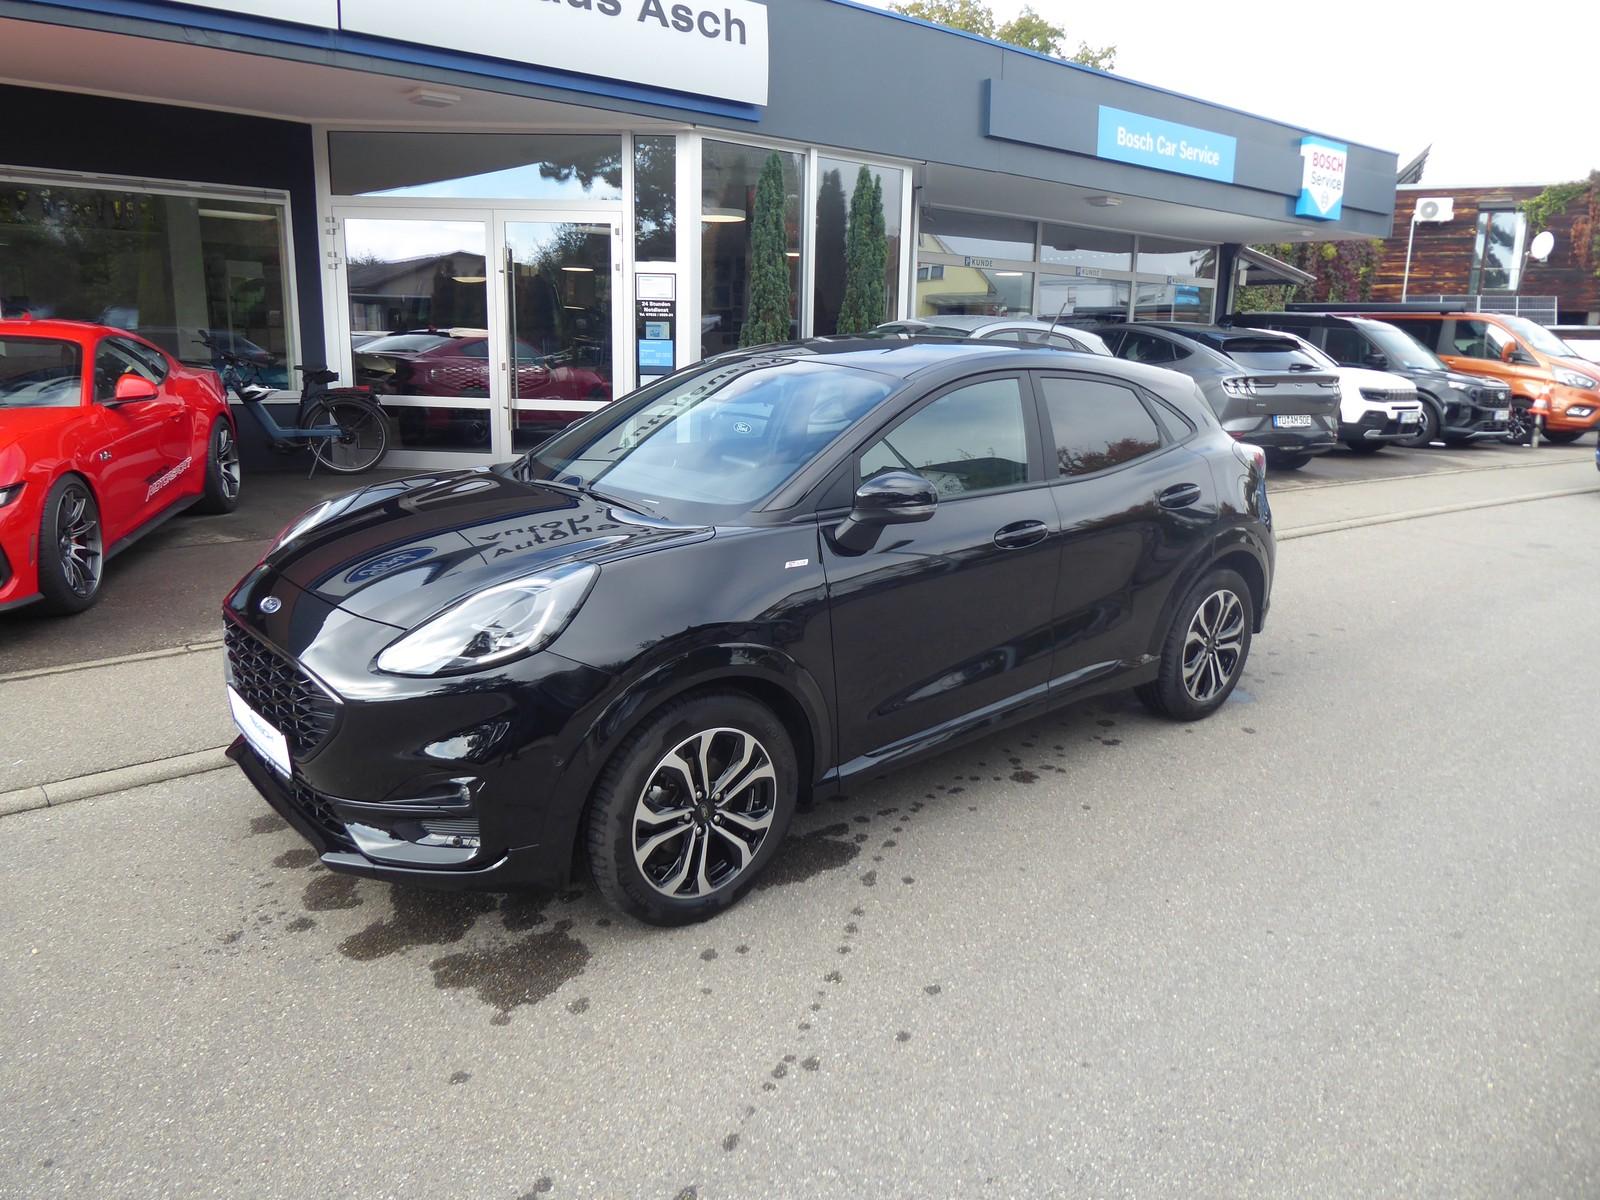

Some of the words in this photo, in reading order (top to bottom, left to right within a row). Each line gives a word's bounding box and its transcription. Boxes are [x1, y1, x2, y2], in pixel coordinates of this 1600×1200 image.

[637, 0, 746, 45] Asch
[1117, 126, 1154, 151] Bosch
[1156, 135, 1177, 157] Car
[1180, 141, 1221, 166] Service
[1312, 152, 1344, 173] BOSCH
[1311, 171, 1342, 191] Service
[971, 257, 993, 268] KUNDE
